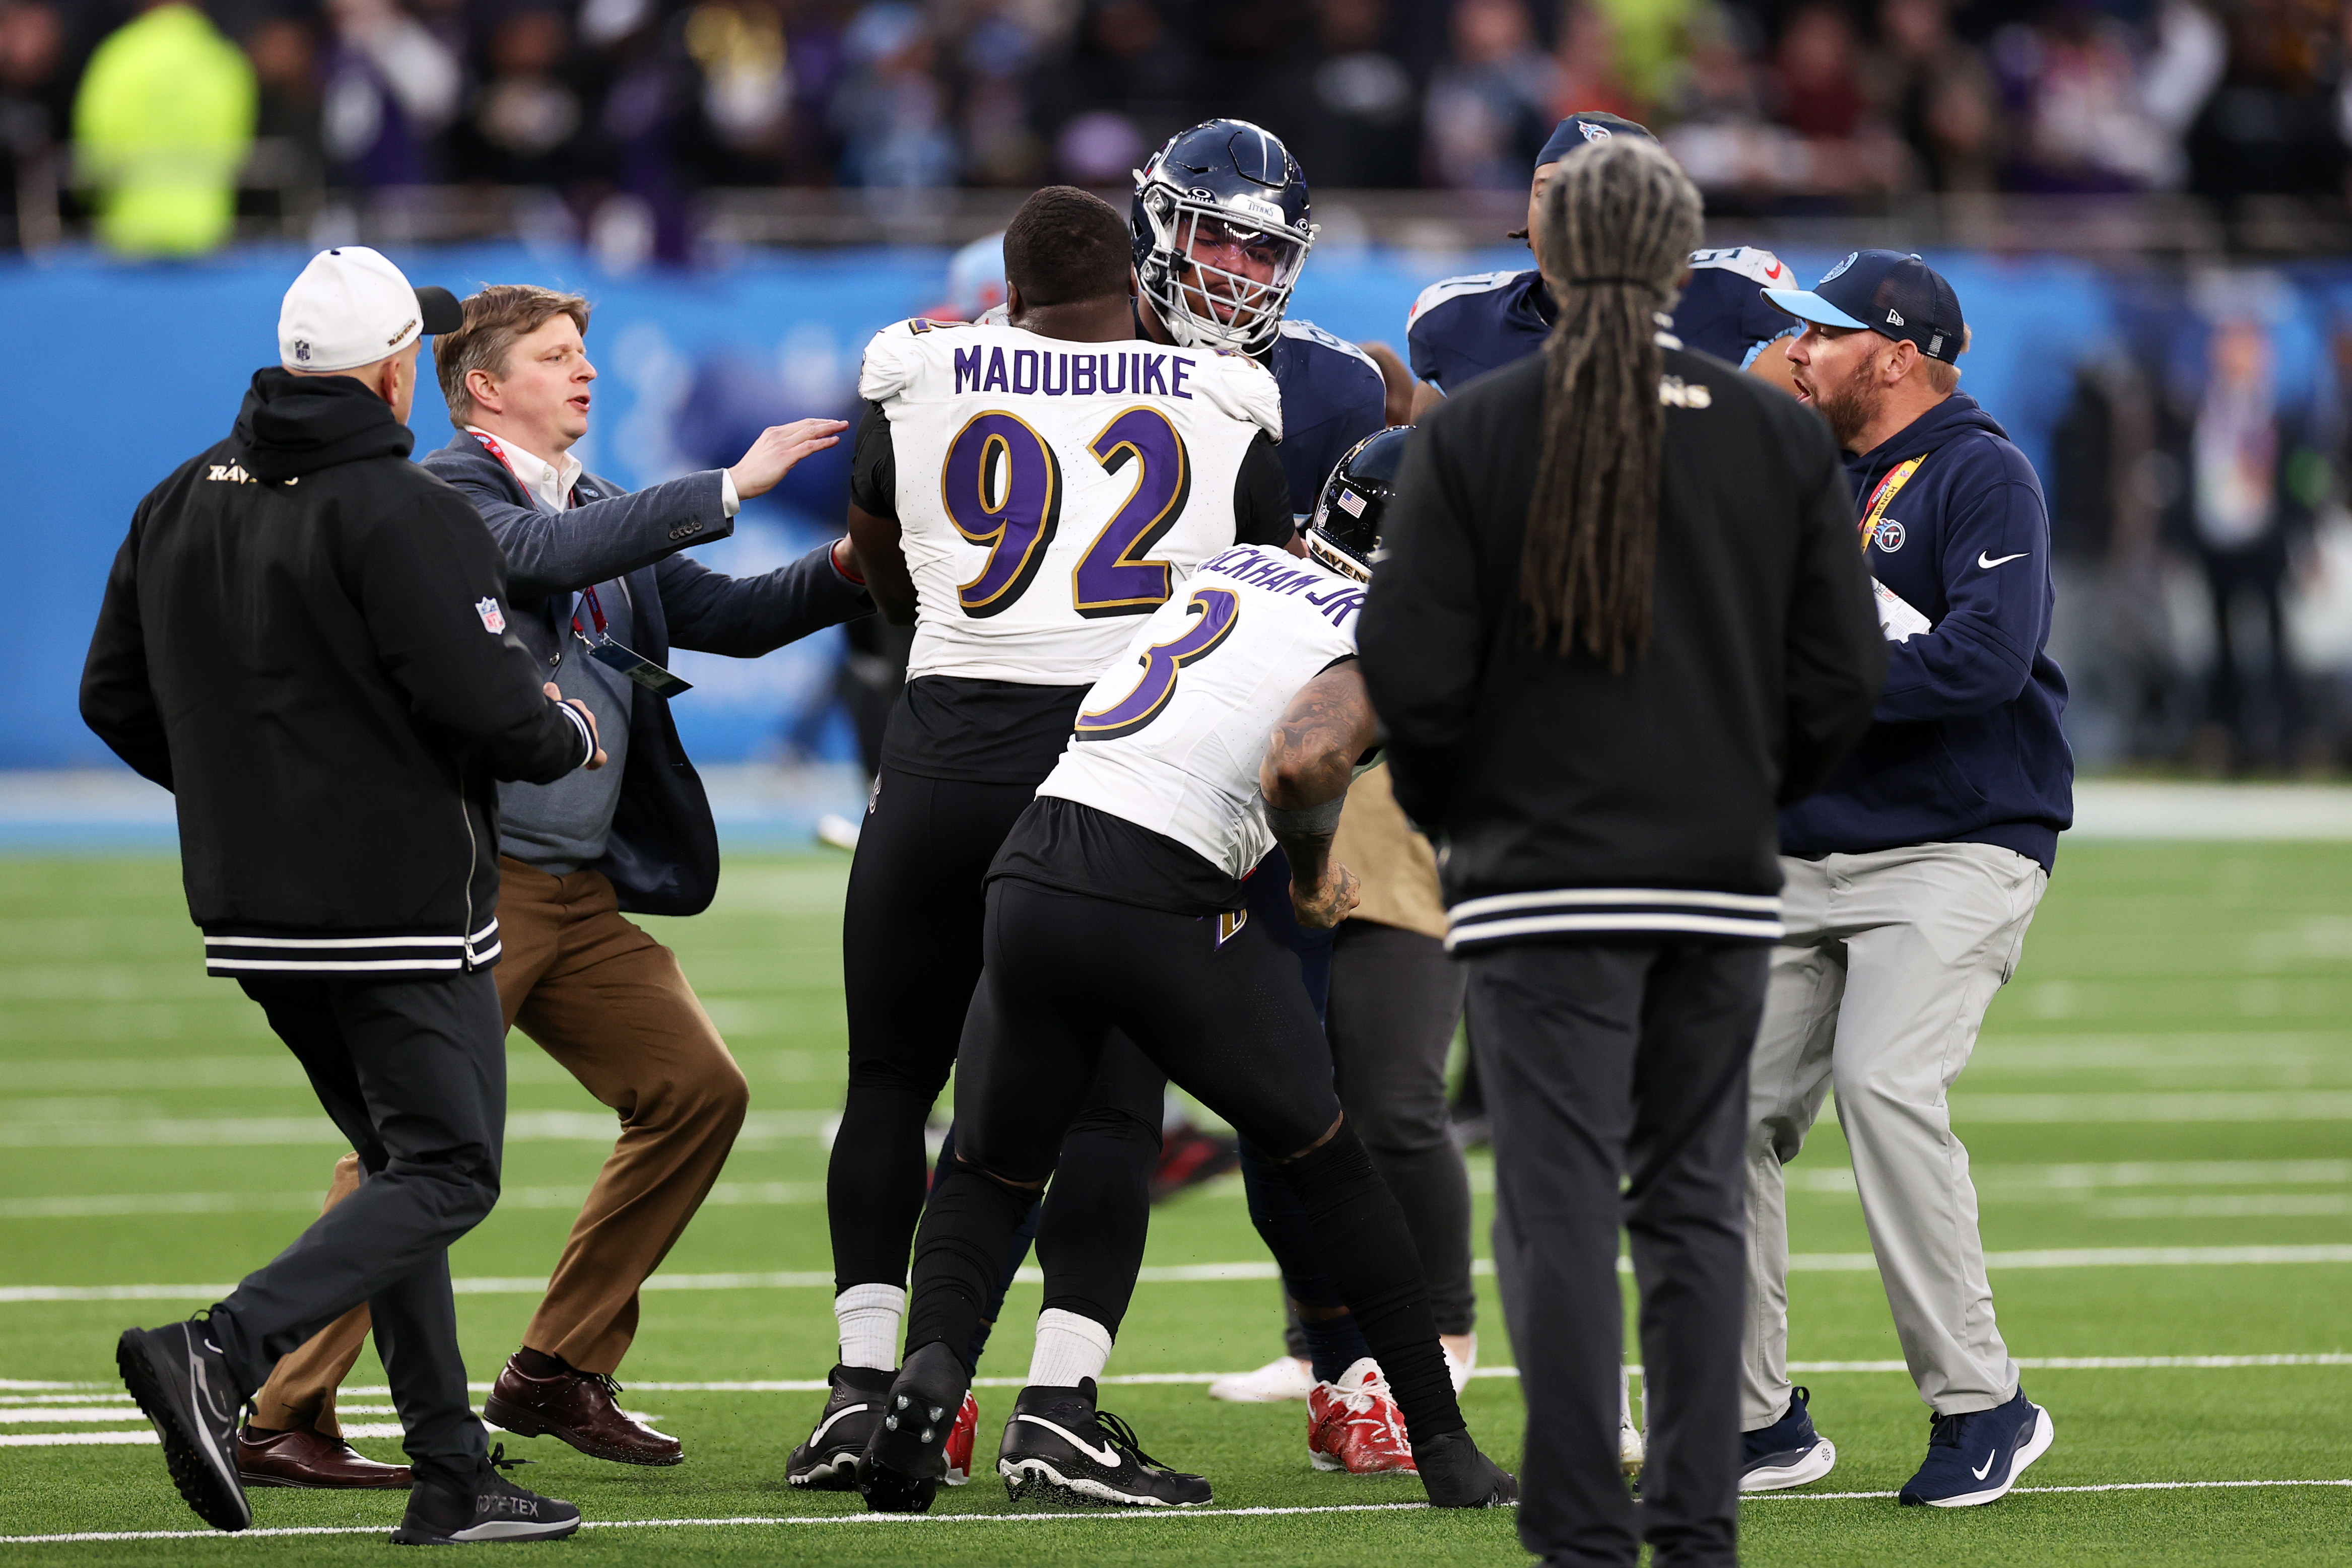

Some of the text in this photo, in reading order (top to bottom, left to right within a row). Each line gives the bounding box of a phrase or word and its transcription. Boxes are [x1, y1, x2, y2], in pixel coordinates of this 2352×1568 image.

[1248, 199, 1274, 217] TITANS
[954, 345, 1196, 400] MADUBUIKE
[941, 404, 1191, 619] 92
[1871, 492, 1883, 504] 2023
[1874, 486, 1898, 515] BENCH
[1311, 539, 1372, 584] RAVEN
[1305, 587, 1367, 628] JR
[1074, 587, 1241, 741] 3
